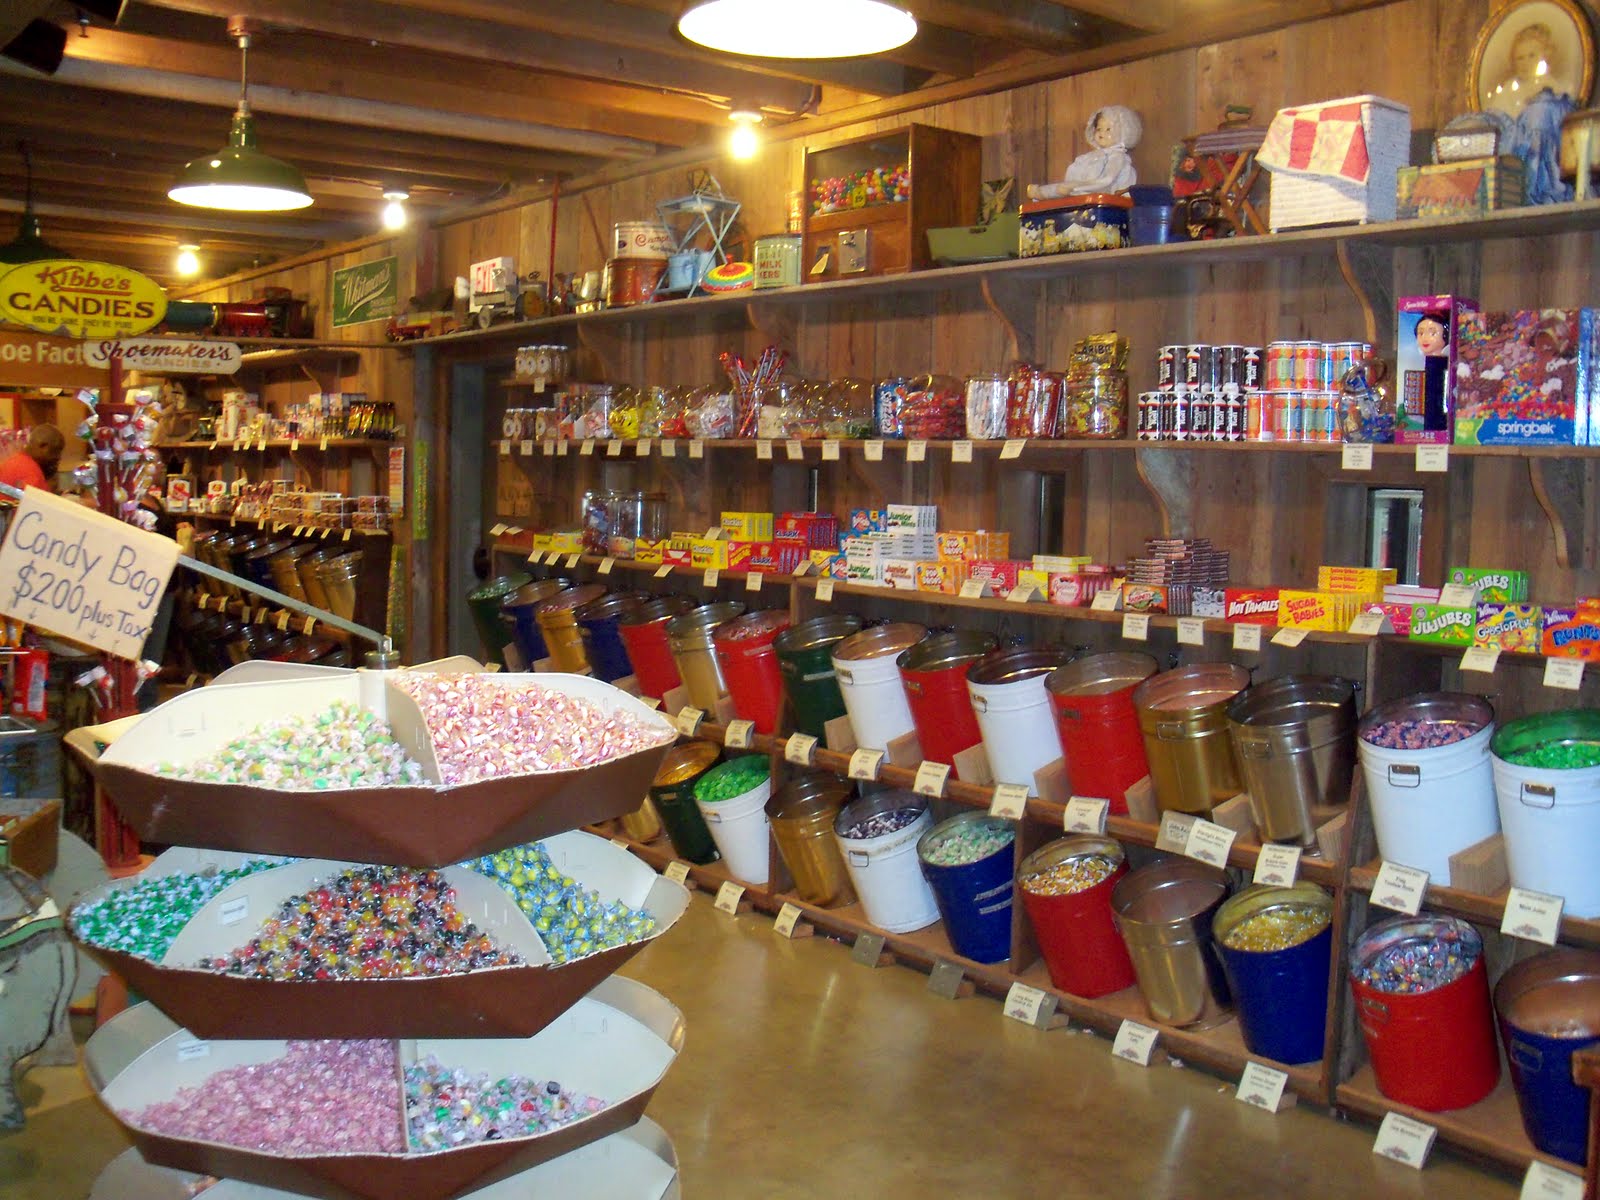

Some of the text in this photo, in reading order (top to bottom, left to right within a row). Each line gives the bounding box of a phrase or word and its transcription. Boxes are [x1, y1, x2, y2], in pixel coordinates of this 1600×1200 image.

[35, 266, 132, 292] Kibbe's
[9, 292, 155, 318] CANDIES
[92, 340, 232, 361] Shoemaker's
[142, 357, 211, 369] CANDIES
[1498, 421, 1555, 437] springbok
[13, 511, 161, 610] Candy Bag
[1228, 599, 1280, 617] HOT TAMALES
[1286, 598, 1317, 613] SUGAR
[1292, 606, 1325, 625] BABIES
[77, 600, 114, 631] plus
[118, 609, 149, 640] Tax
[1413, 611, 1473, 635] JUJUBES
